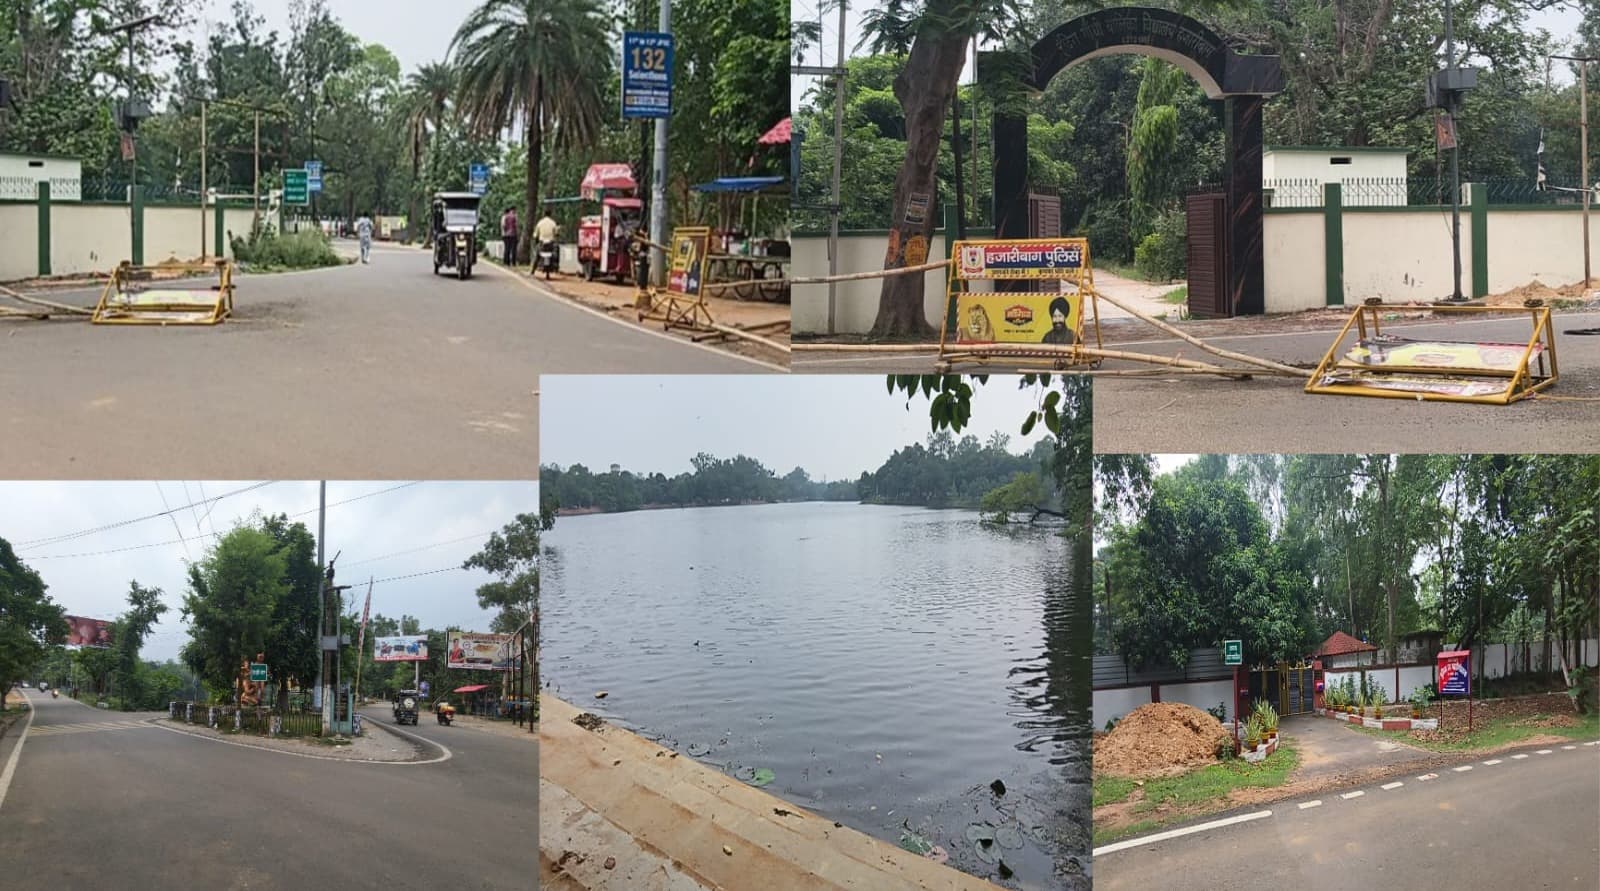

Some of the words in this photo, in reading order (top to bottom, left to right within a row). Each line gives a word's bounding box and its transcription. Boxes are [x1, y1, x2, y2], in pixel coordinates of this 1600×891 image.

[631, 47, 665, 70] 132
[986, 247, 1042, 264] हजारीबाग
[1045, 246, 1080, 268] पुलिस
